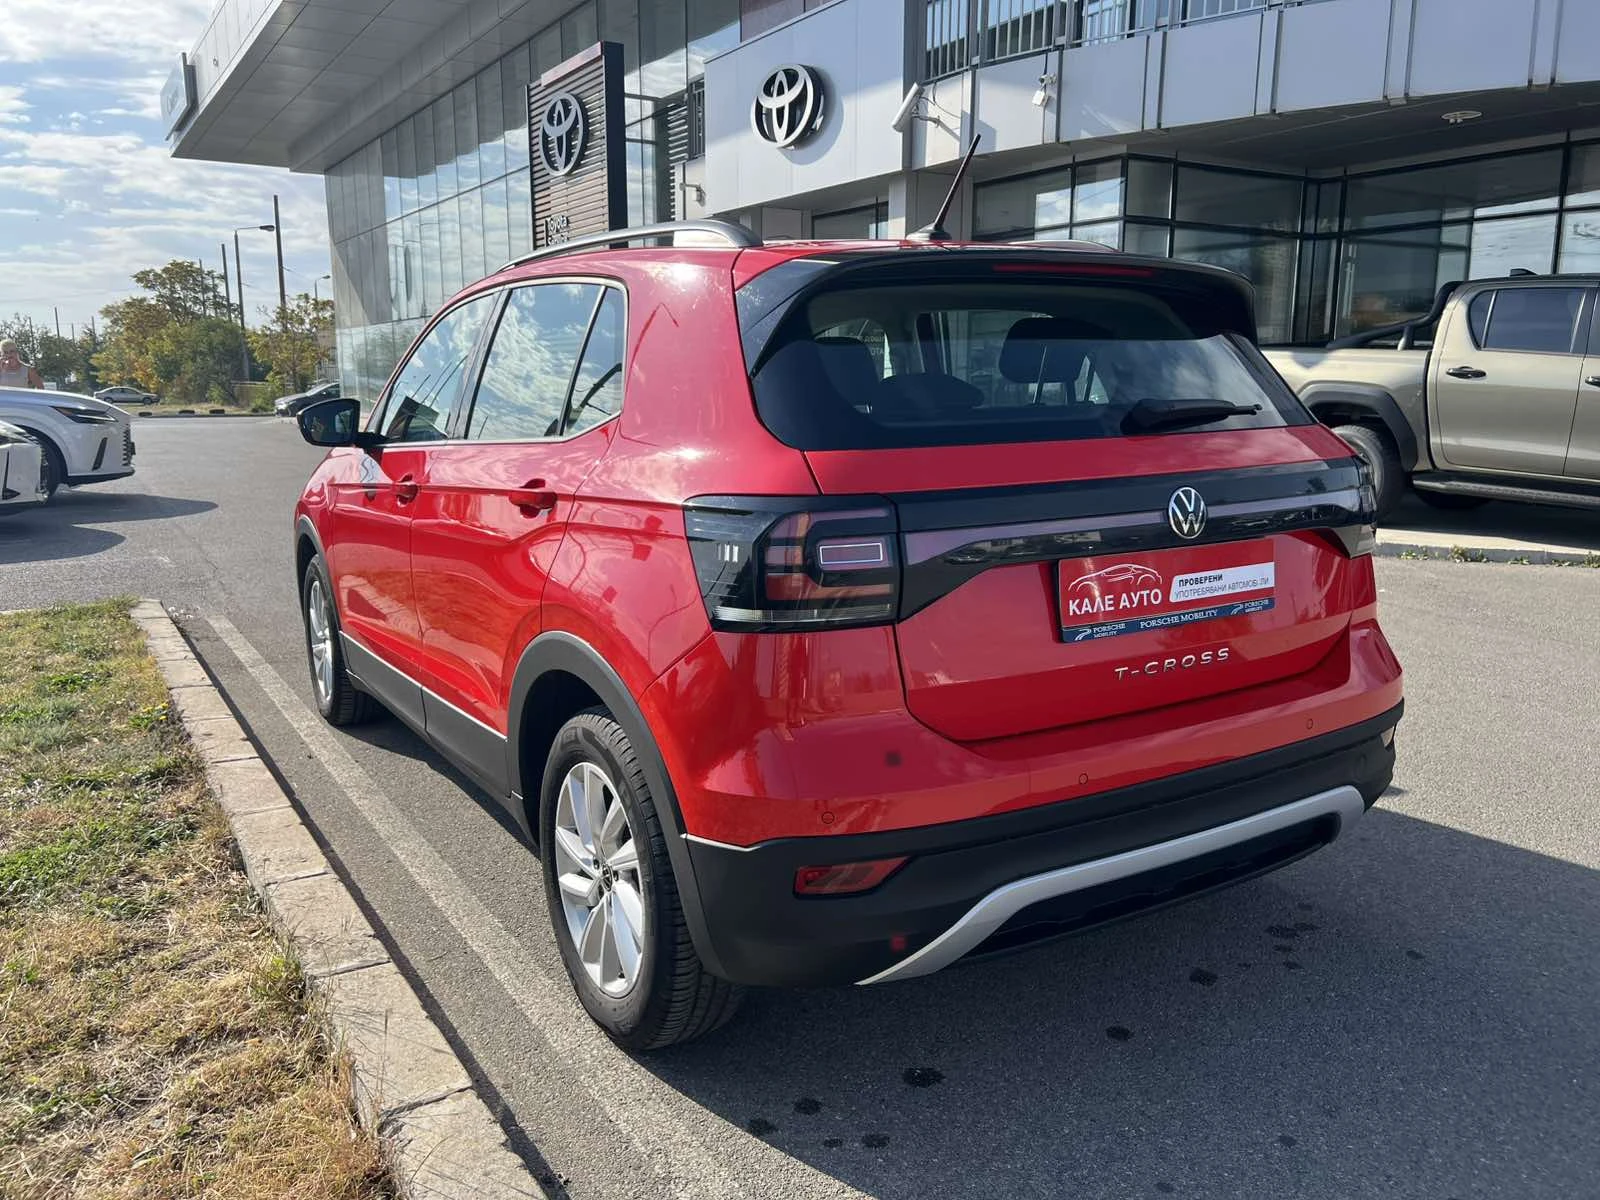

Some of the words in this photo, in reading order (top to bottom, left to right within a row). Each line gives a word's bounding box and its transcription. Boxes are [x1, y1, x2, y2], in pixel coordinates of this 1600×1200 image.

[1178, 574, 1223, 587] ПРОВЕРЕНИ
[1069, 595, 1114, 616] КАЛЕ
[1119, 589, 1162, 610] АУТО
[1093, 623, 1126, 633] PORSCHE
[1140, 615, 1179, 629] PORSCHE
[1180, 608, 1218, 622] MOBILITY
[1114, 647, 1229, 680] T-CROSS
